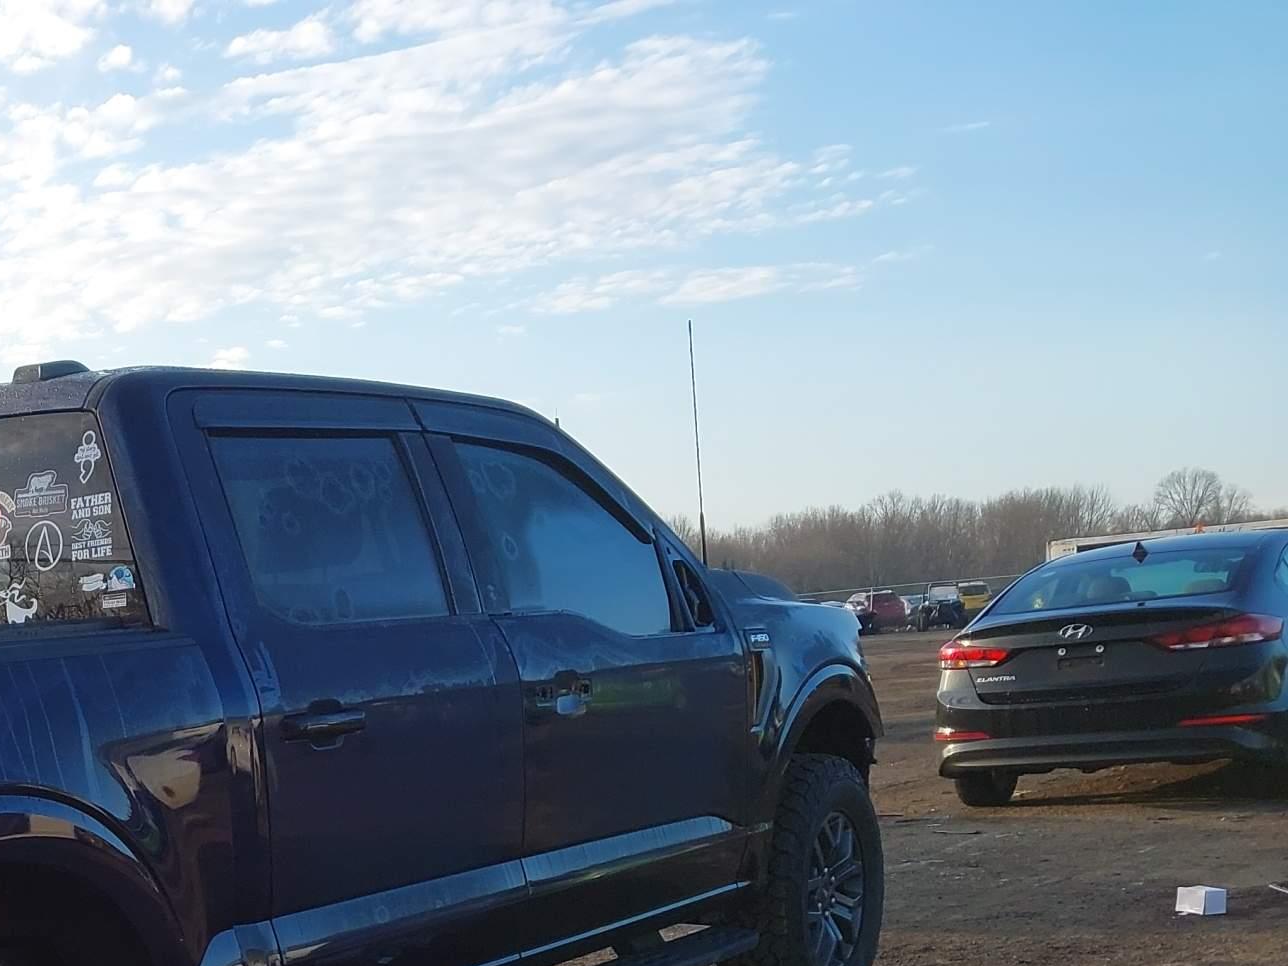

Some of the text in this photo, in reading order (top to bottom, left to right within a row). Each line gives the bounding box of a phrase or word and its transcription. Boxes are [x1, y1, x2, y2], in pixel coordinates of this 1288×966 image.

[71, 491, 112, 510] FATHER
[71, 503, 112, 520] AND SON
[71, 545, 113, 561] FOR LIFE
[751, 633, 769, 642] F-150
[976, 674, 1016, 683] ELANTRA
